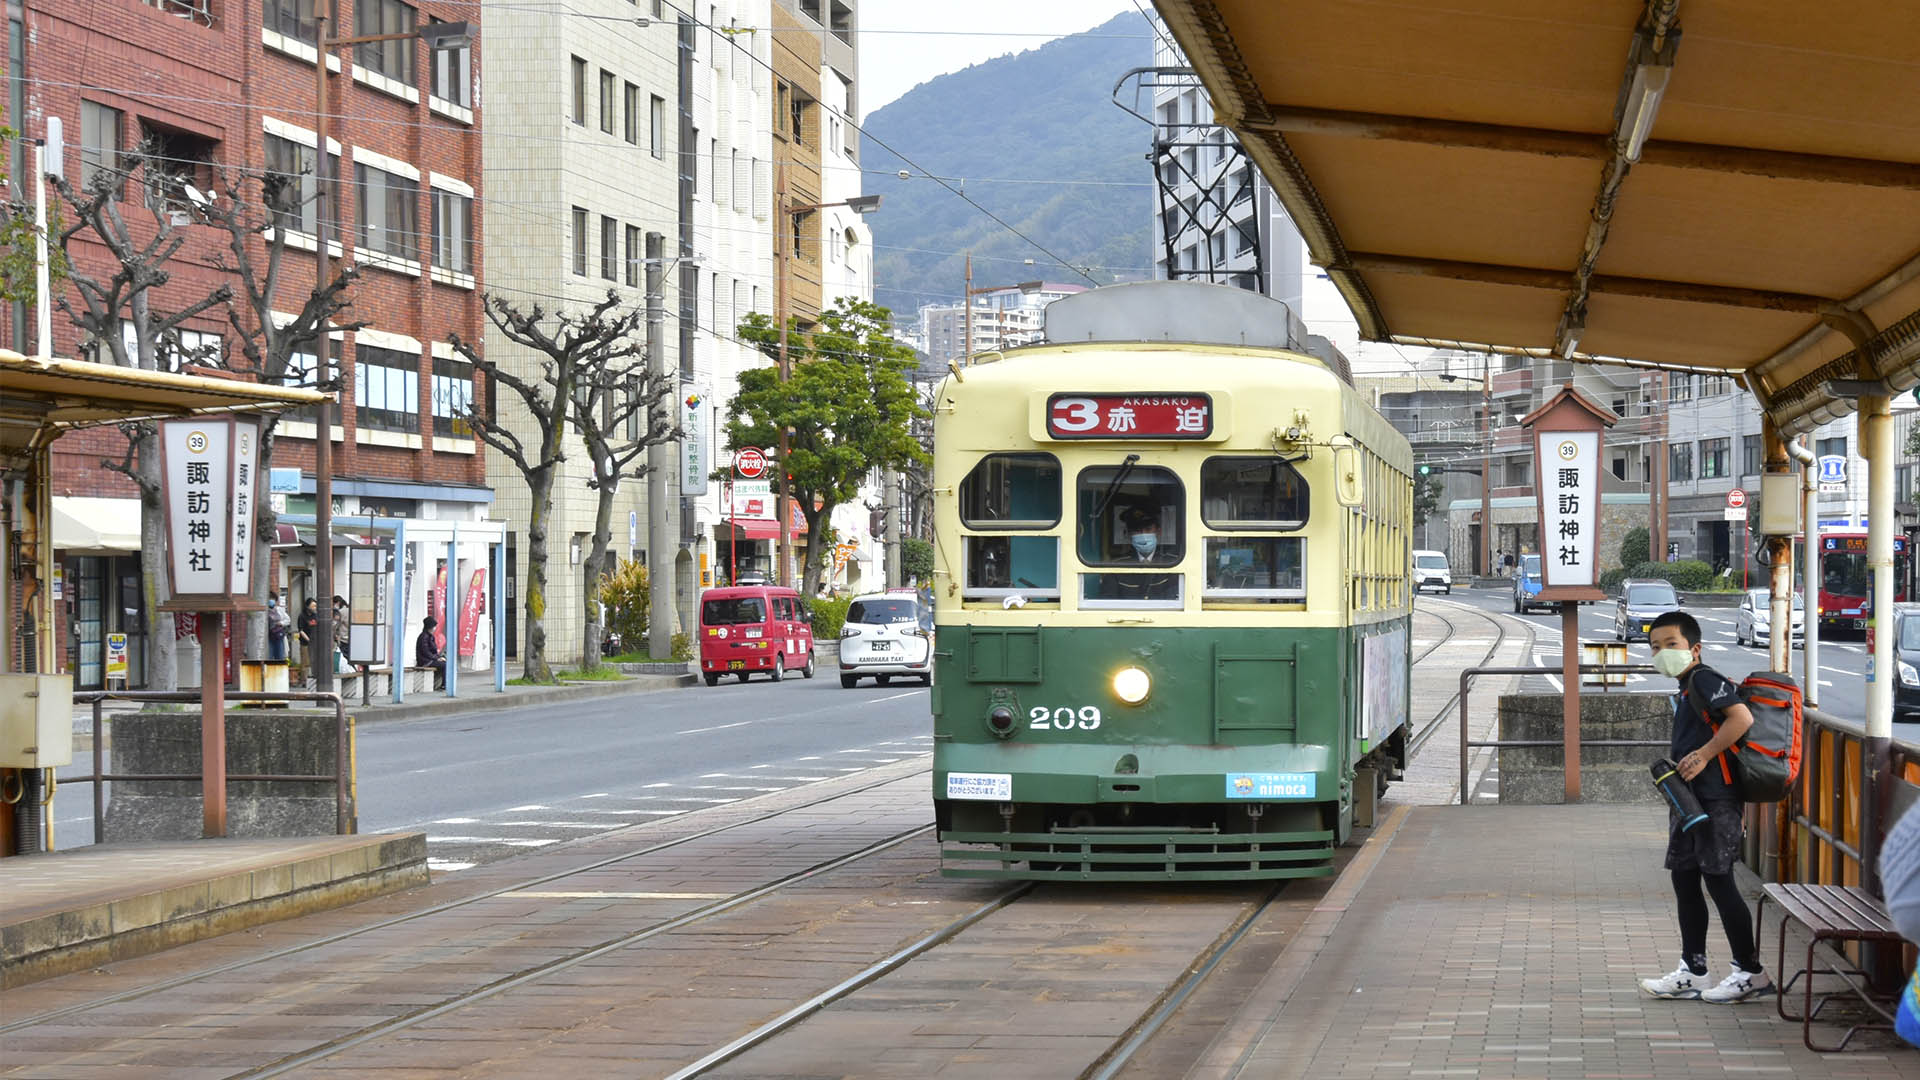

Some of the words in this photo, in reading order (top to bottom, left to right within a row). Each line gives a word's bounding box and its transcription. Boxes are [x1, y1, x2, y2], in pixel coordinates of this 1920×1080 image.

[1123, 398, 1189, 406] AKASAKO
[1052, 398, 1100, 431] 3
[191, 437, 203, 447] 39
[1562, 446, 1574, 455] 39
[187, 462, 211, 572] 諏訪神社
[1558, 468, 1580, 566] 諏訪神社
[1030, 706, 1101, 730] 209
[1260, 781, 1307, 796] nimoca
